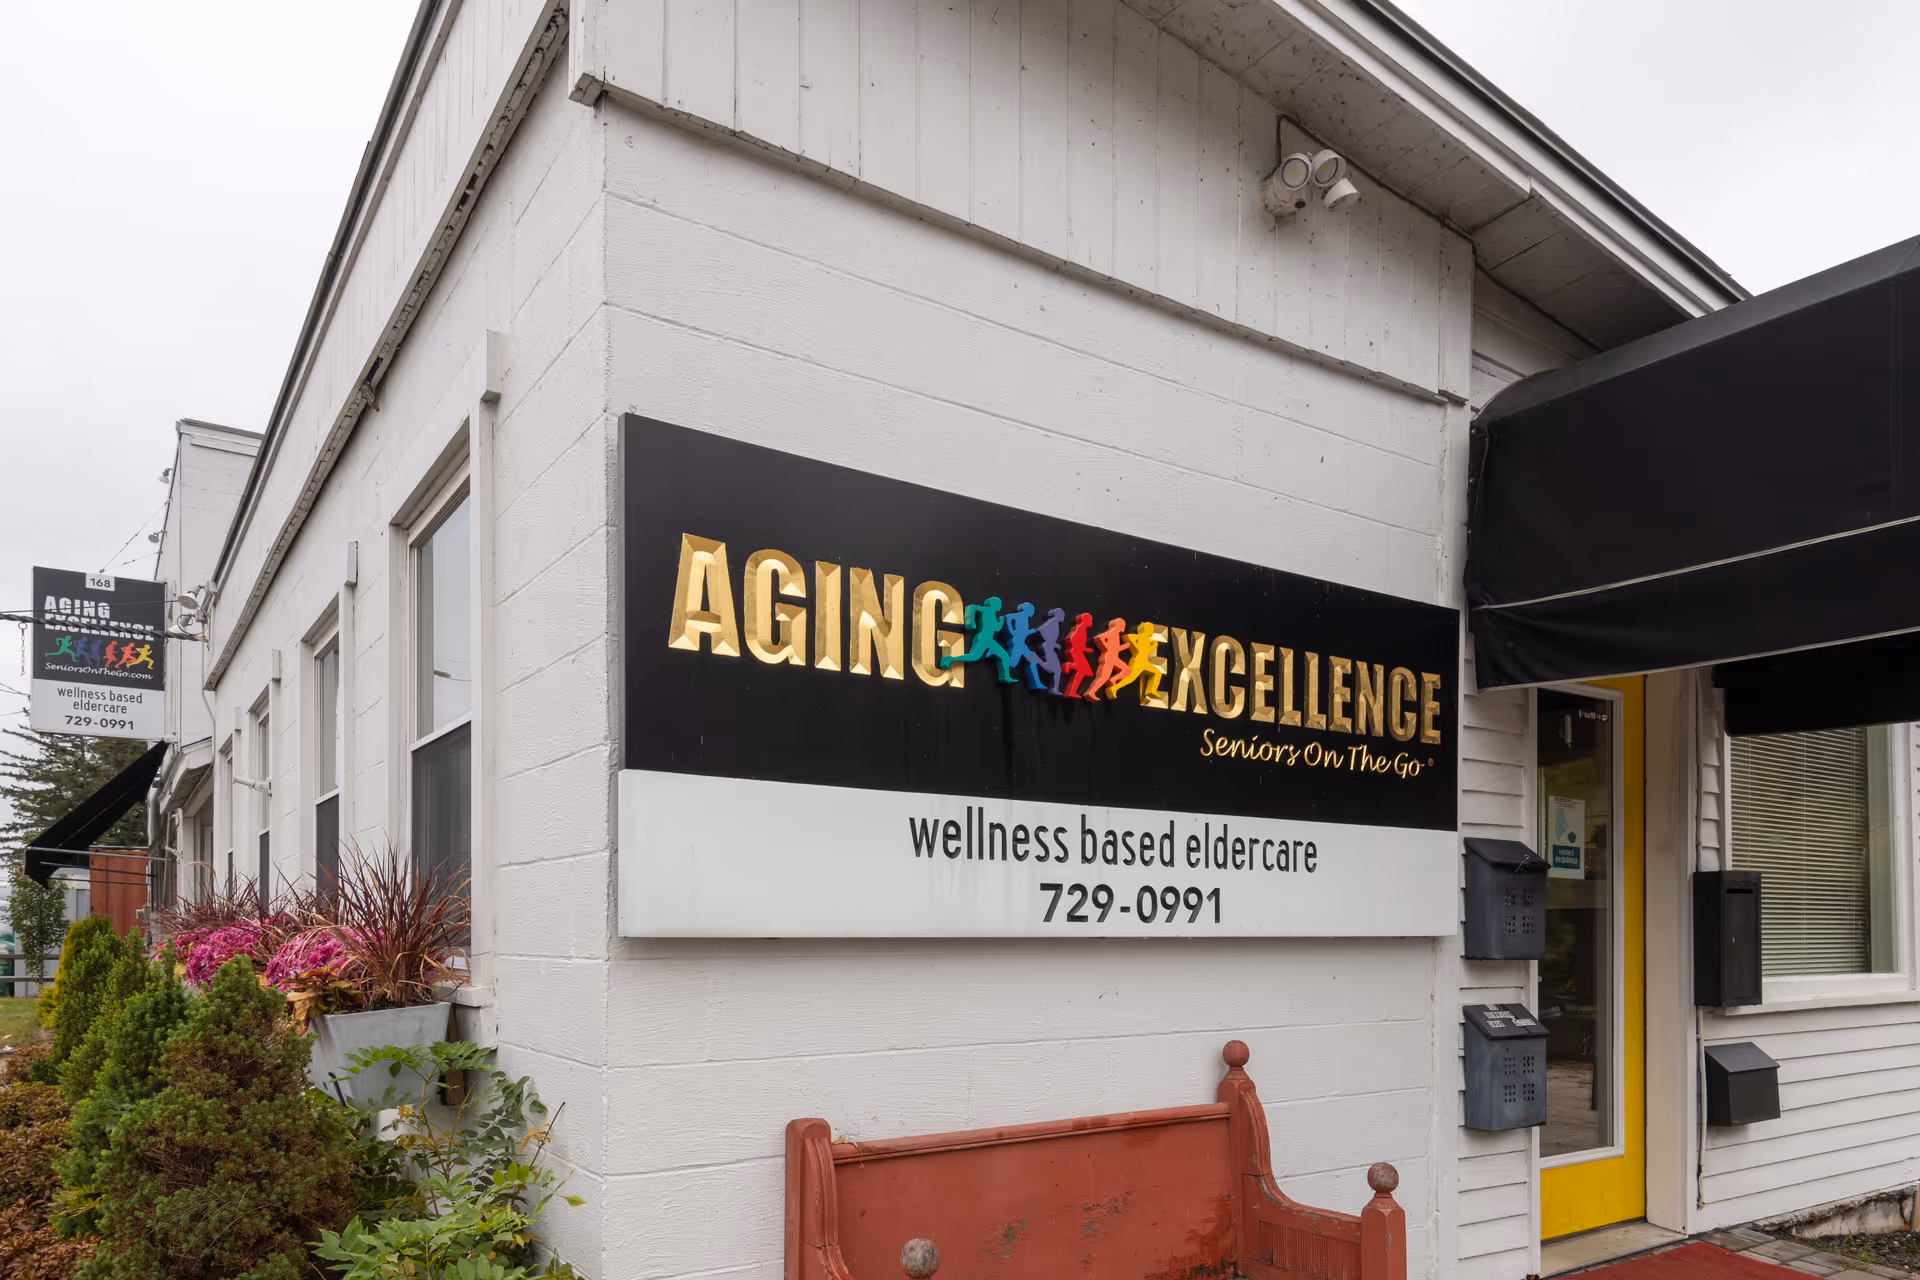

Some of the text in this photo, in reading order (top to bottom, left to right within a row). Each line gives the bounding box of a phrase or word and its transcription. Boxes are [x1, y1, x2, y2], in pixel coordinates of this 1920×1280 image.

[90, 578, 111, 588] 168
[44, 595, 111, 619] AGING
[668, 532, 1442, 744] AGING EXCELLENCE
[45, 662, 154, 680] SeniorsOnTheGo.com
[57, 687, 143, 704] wellness based
[73, 699, 128, 714] eldercare
[64, 715, 134, 730] 729-0991
[1200, 728, 1302, 767] Seniors
[1304, 741, 1344, 770] On
[1347, 744, 1391, 774] The
[909, 806, 1318, 873] wellness based eldercare
[1040, 883, 1222, 923] 729-0991
